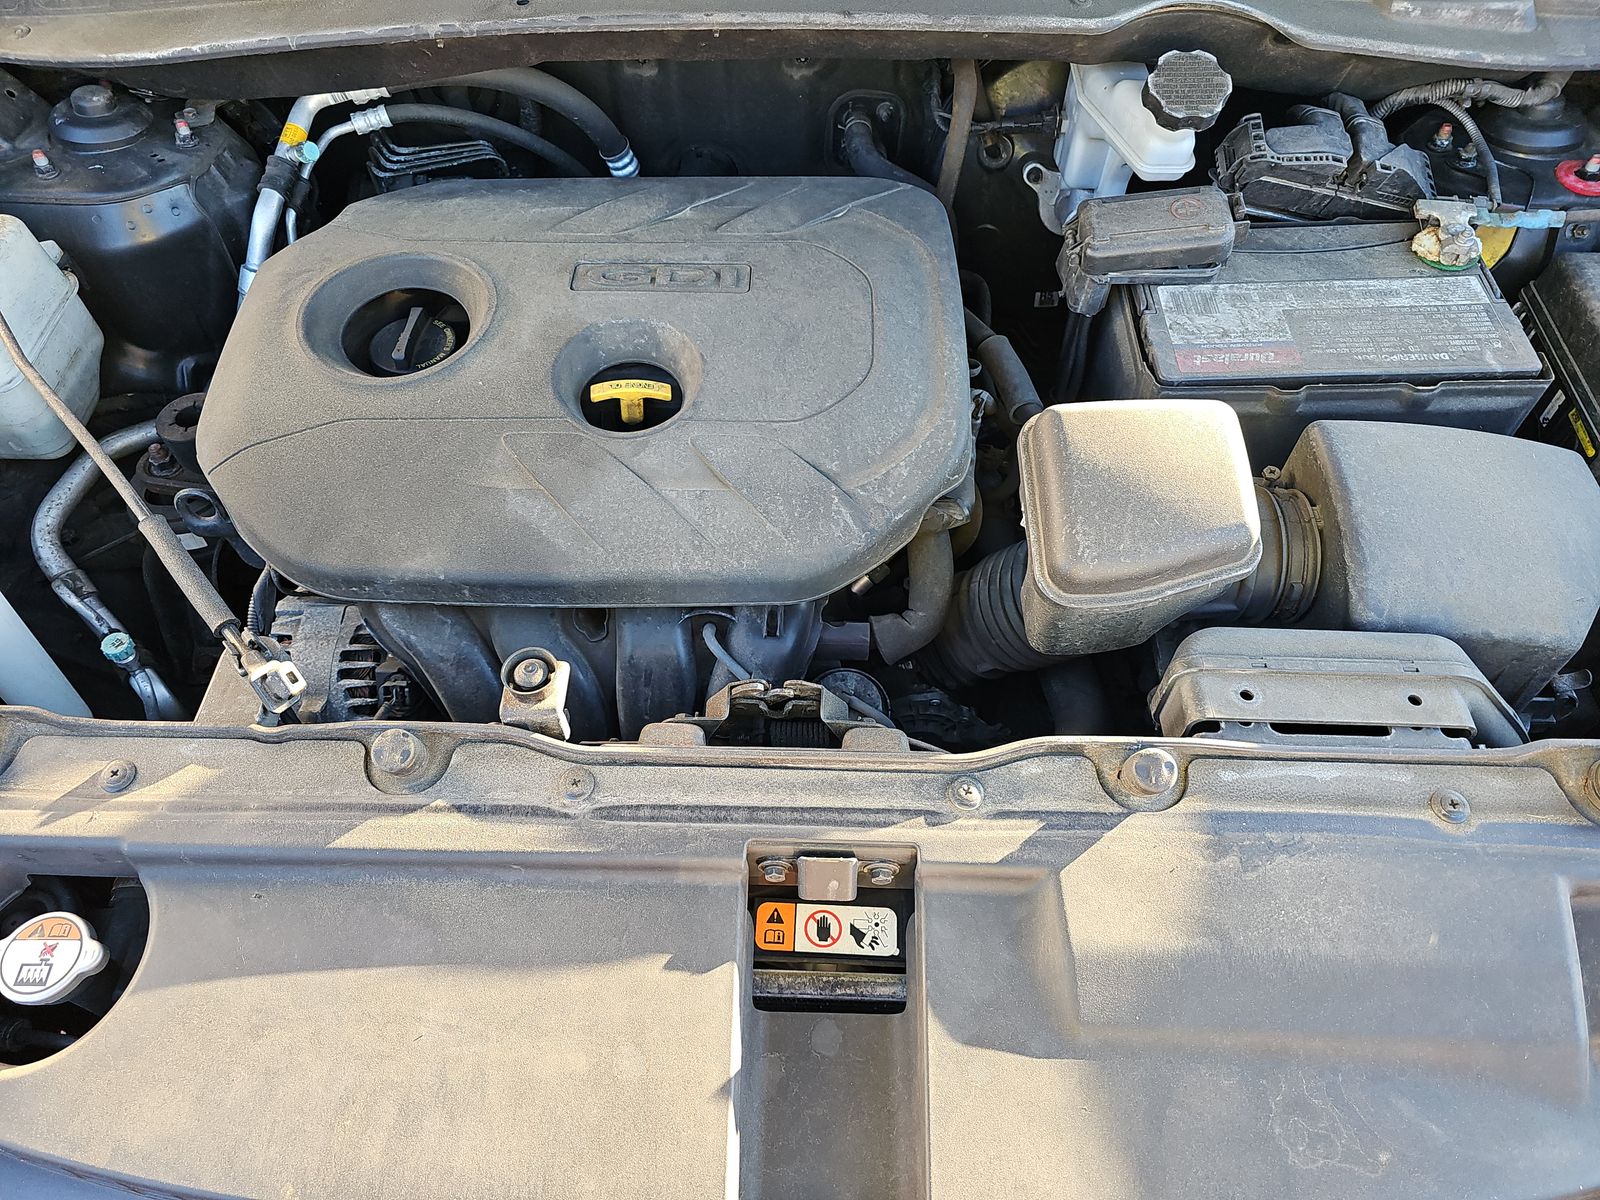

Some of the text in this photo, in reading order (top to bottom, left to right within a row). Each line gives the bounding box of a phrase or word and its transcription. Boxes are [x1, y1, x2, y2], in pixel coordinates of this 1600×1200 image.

[586, 264, 740, 289] GDI
[432, 320, 446, 328] SEE
[416, 352, 446, 369] MANUAL
[1193, 351, 1280, 366] Duralast
